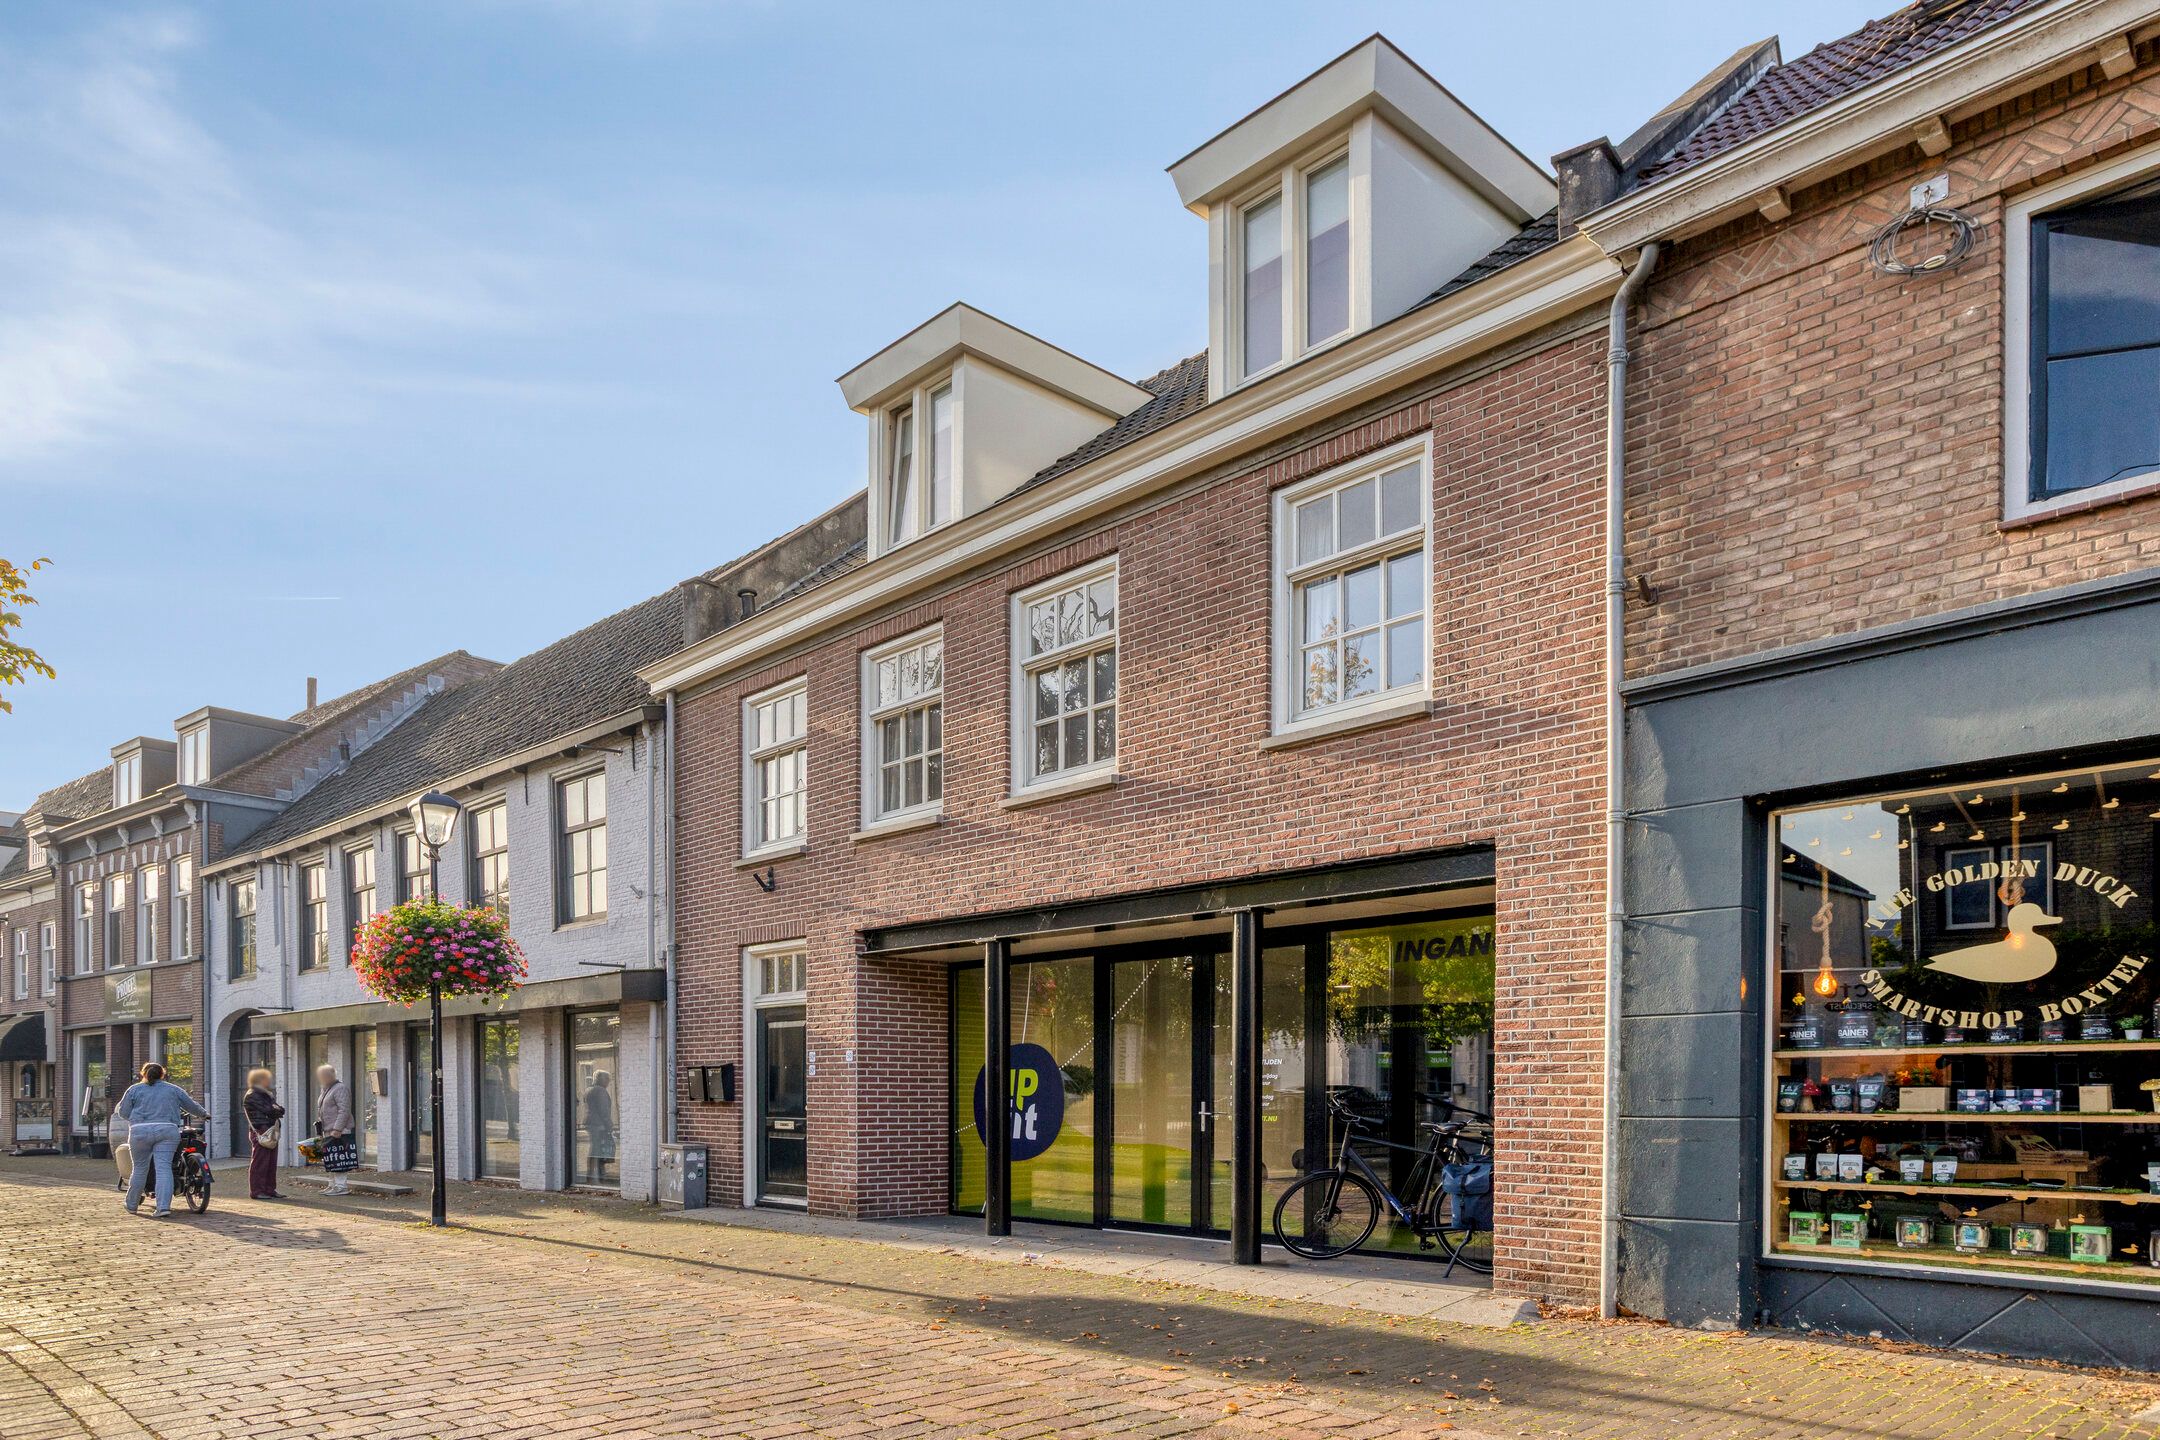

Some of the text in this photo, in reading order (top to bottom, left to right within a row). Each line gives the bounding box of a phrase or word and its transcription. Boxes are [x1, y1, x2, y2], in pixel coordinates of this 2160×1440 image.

[1864, 860, 2139, 930] THE GOLDEN DUCK
[1395, 932, 1495, 963] INGAN
[1859, 953, 2150, 1029] SMARTSHOP BOXTEL
